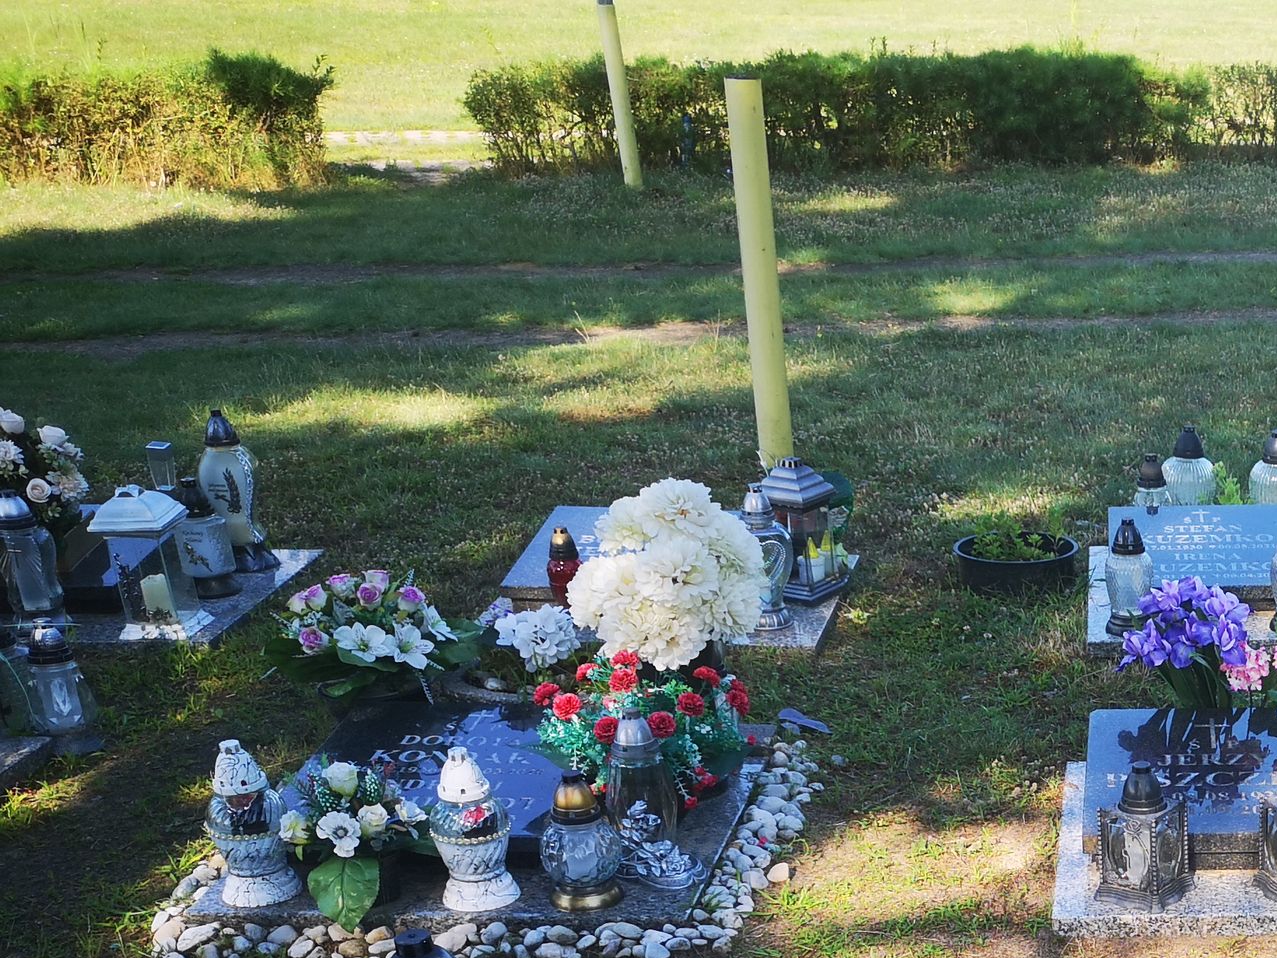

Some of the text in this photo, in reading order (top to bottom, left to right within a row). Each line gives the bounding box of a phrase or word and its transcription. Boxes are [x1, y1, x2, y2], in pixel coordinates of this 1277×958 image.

[1163, 524, 1243, 533] STEFAN
[1174, 553, 1242, 561] IRENA
[1153, 562, 1271, 572] UZEMK
[1156, 753, 1263, 766] JERZY
